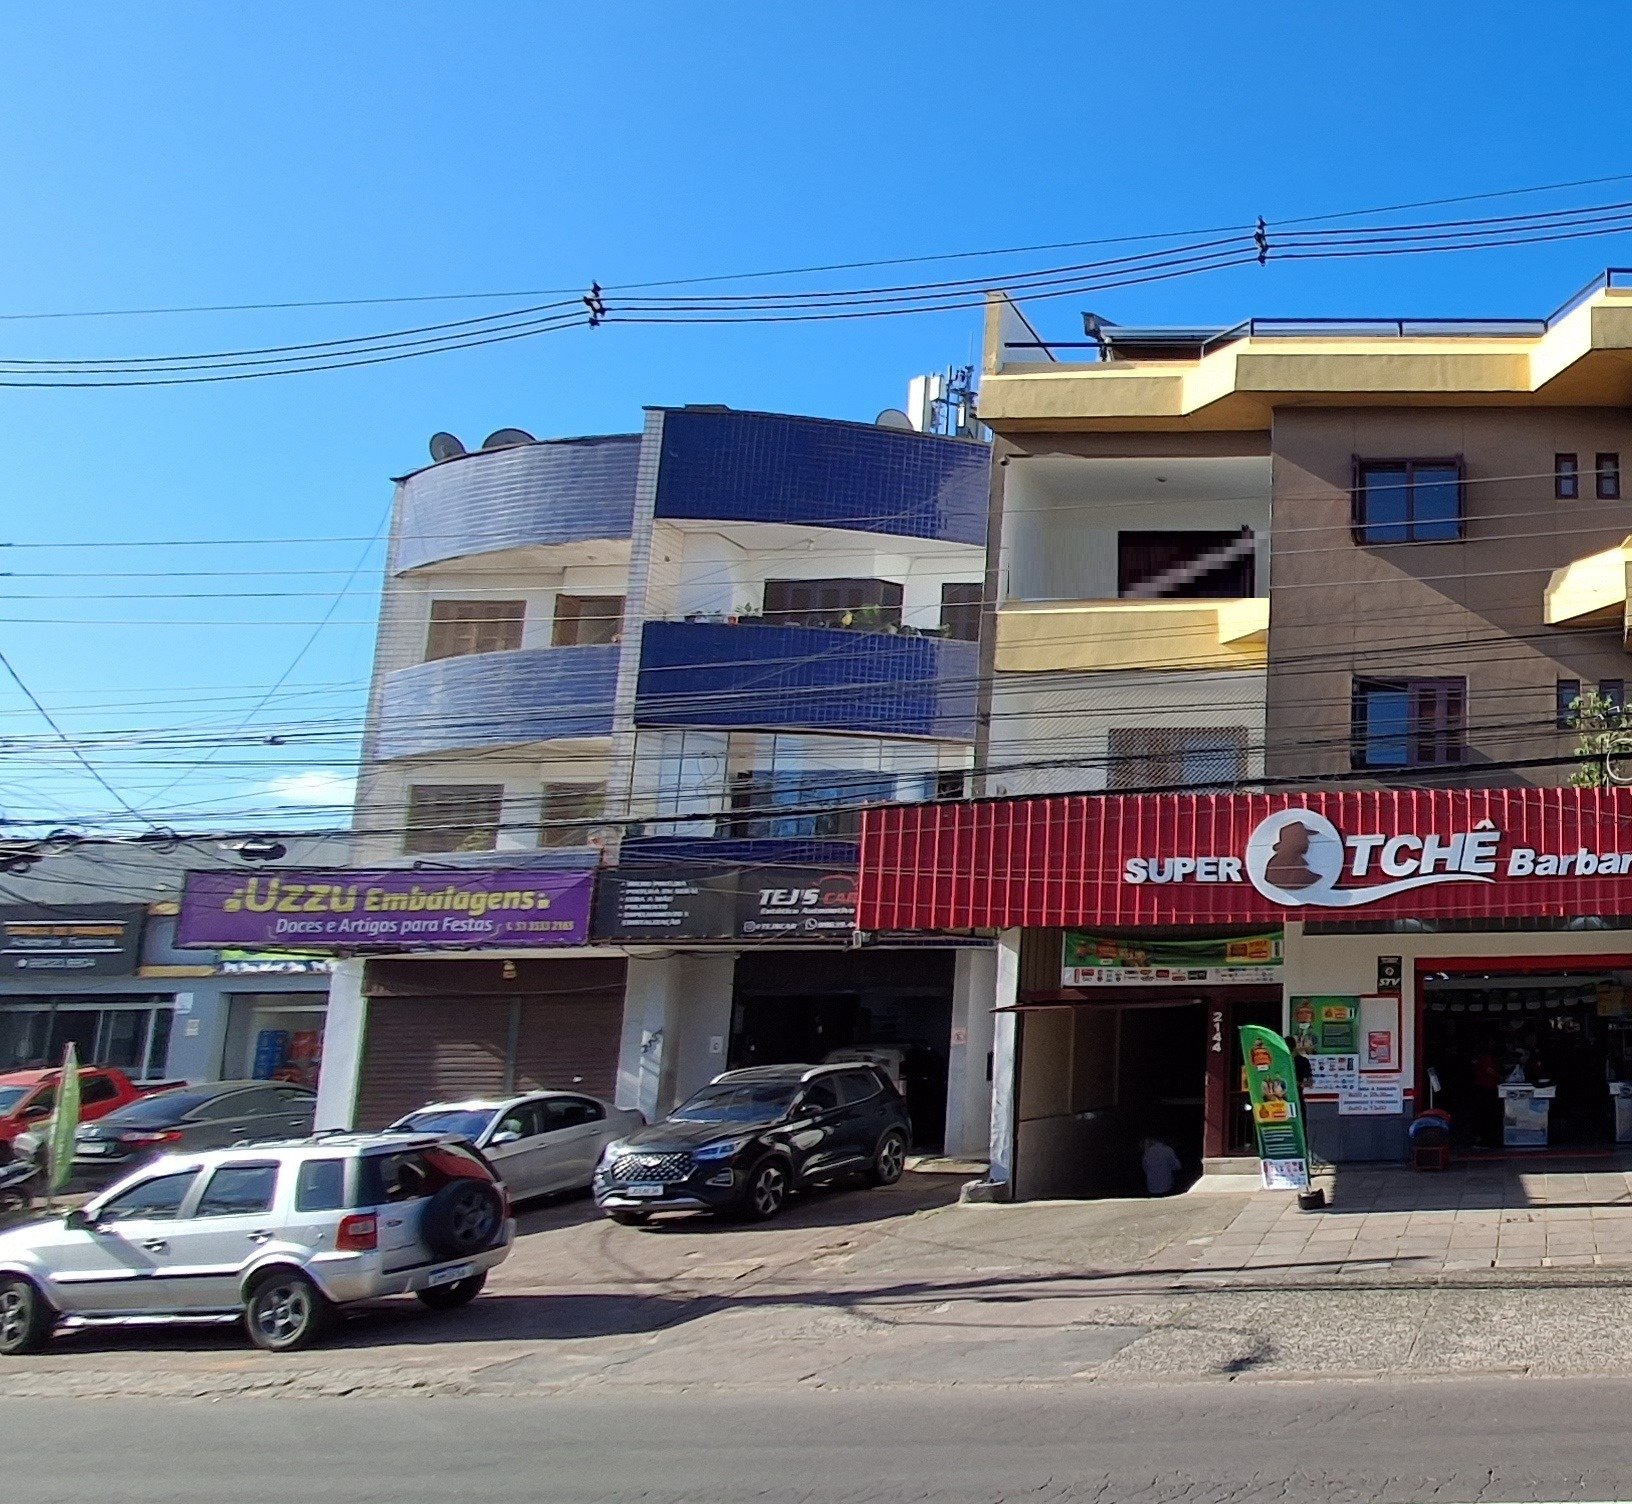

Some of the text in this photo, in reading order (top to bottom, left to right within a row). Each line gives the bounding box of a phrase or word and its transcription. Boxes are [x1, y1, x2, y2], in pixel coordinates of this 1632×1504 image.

[1124, 856, 1243, 884] SUPER
[364, 886, 535, 916] Embalagens
[759, 889, 820, 905] TEJ'S
[276, 917, 494, 936] Doces e Artigos para Festas
[1211, 1011, 1223, 1053] 2144
